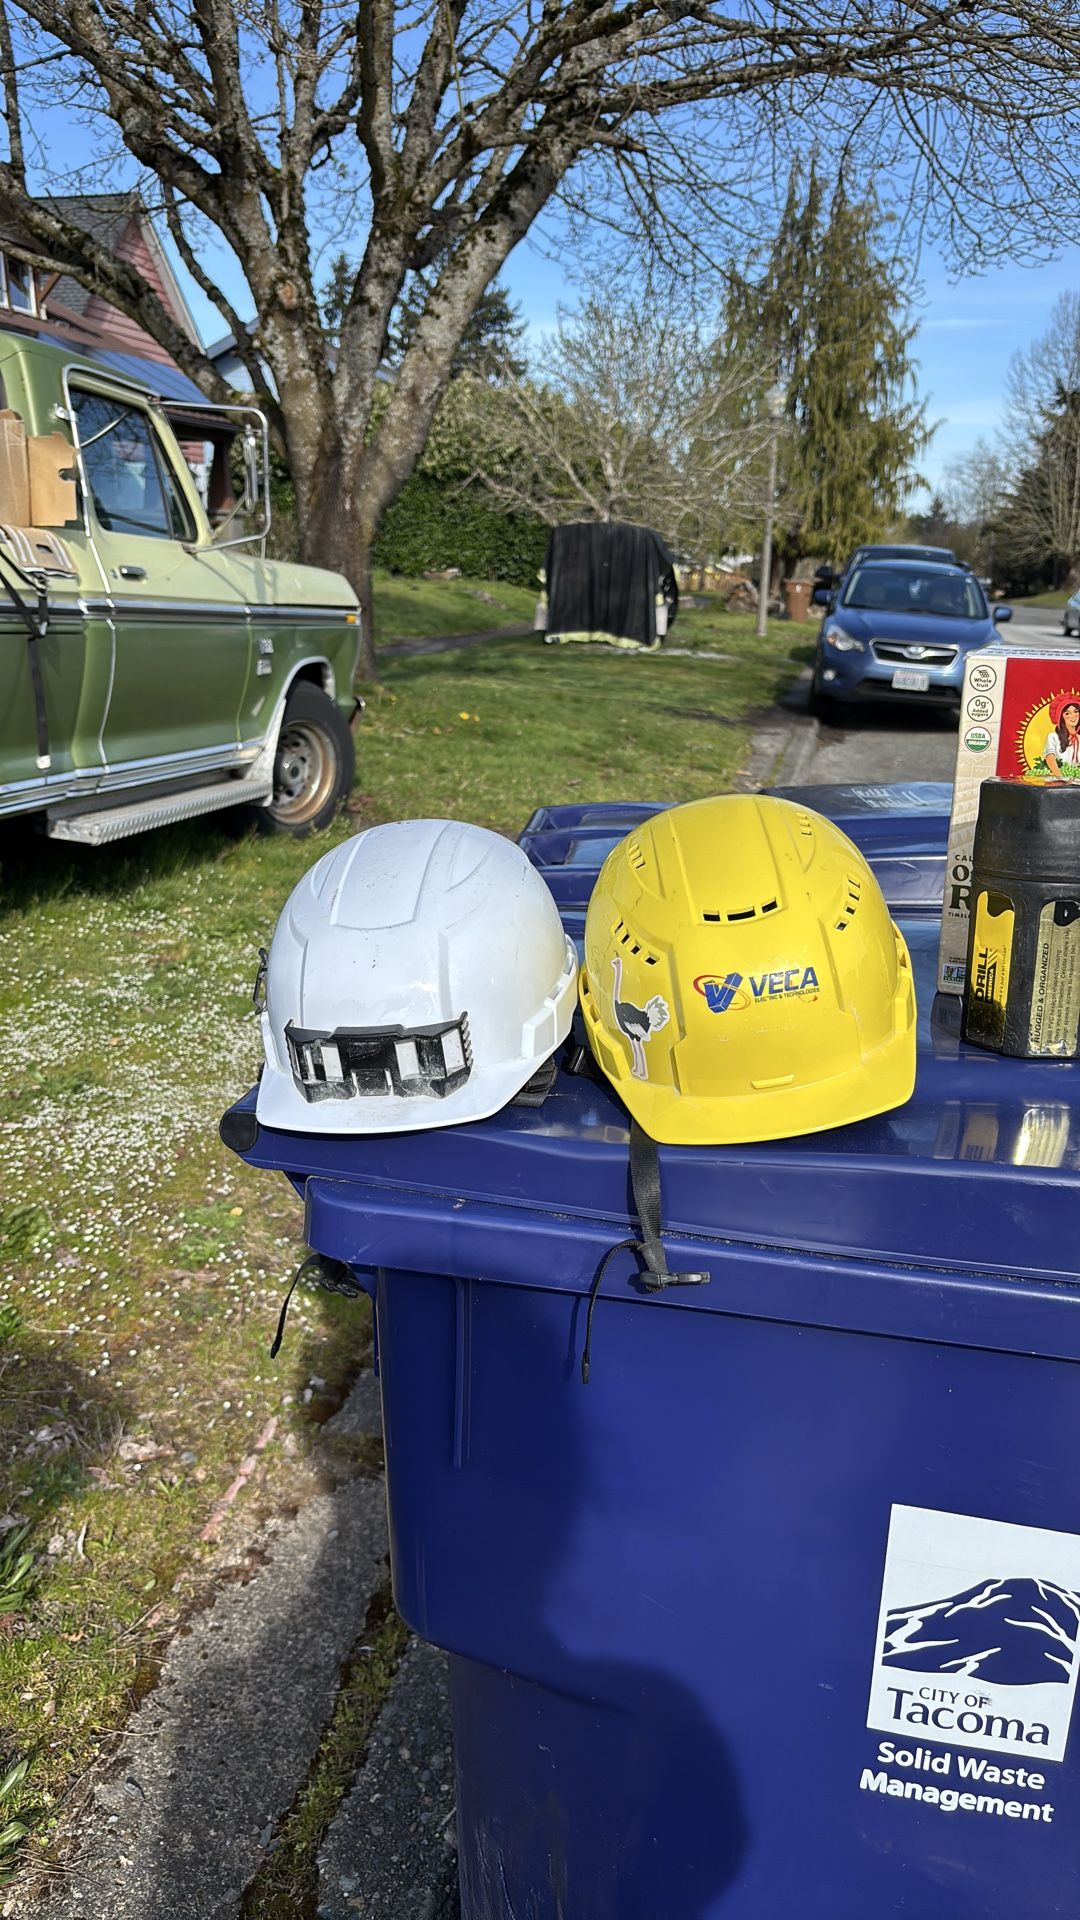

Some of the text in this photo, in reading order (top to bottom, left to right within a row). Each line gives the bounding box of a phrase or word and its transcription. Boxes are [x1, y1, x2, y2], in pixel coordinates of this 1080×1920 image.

[749, 967, 819, 997] VECA
[784, 987, 820, 998] TECHNOLOGIES
[975, 947, 988, 1001] DRILL
[1034, 1005, 1043, 1043] RUGGED
[1039, 943, 1049, 995] ORGANIZED
[886, 1686, 1050, 1746] Tacoma
[918, 1686, 990, 1709] CITY OF
[877, 1741, 1046, 1790] Solid Waste
[859, 1768, 1055, 1823] Management
